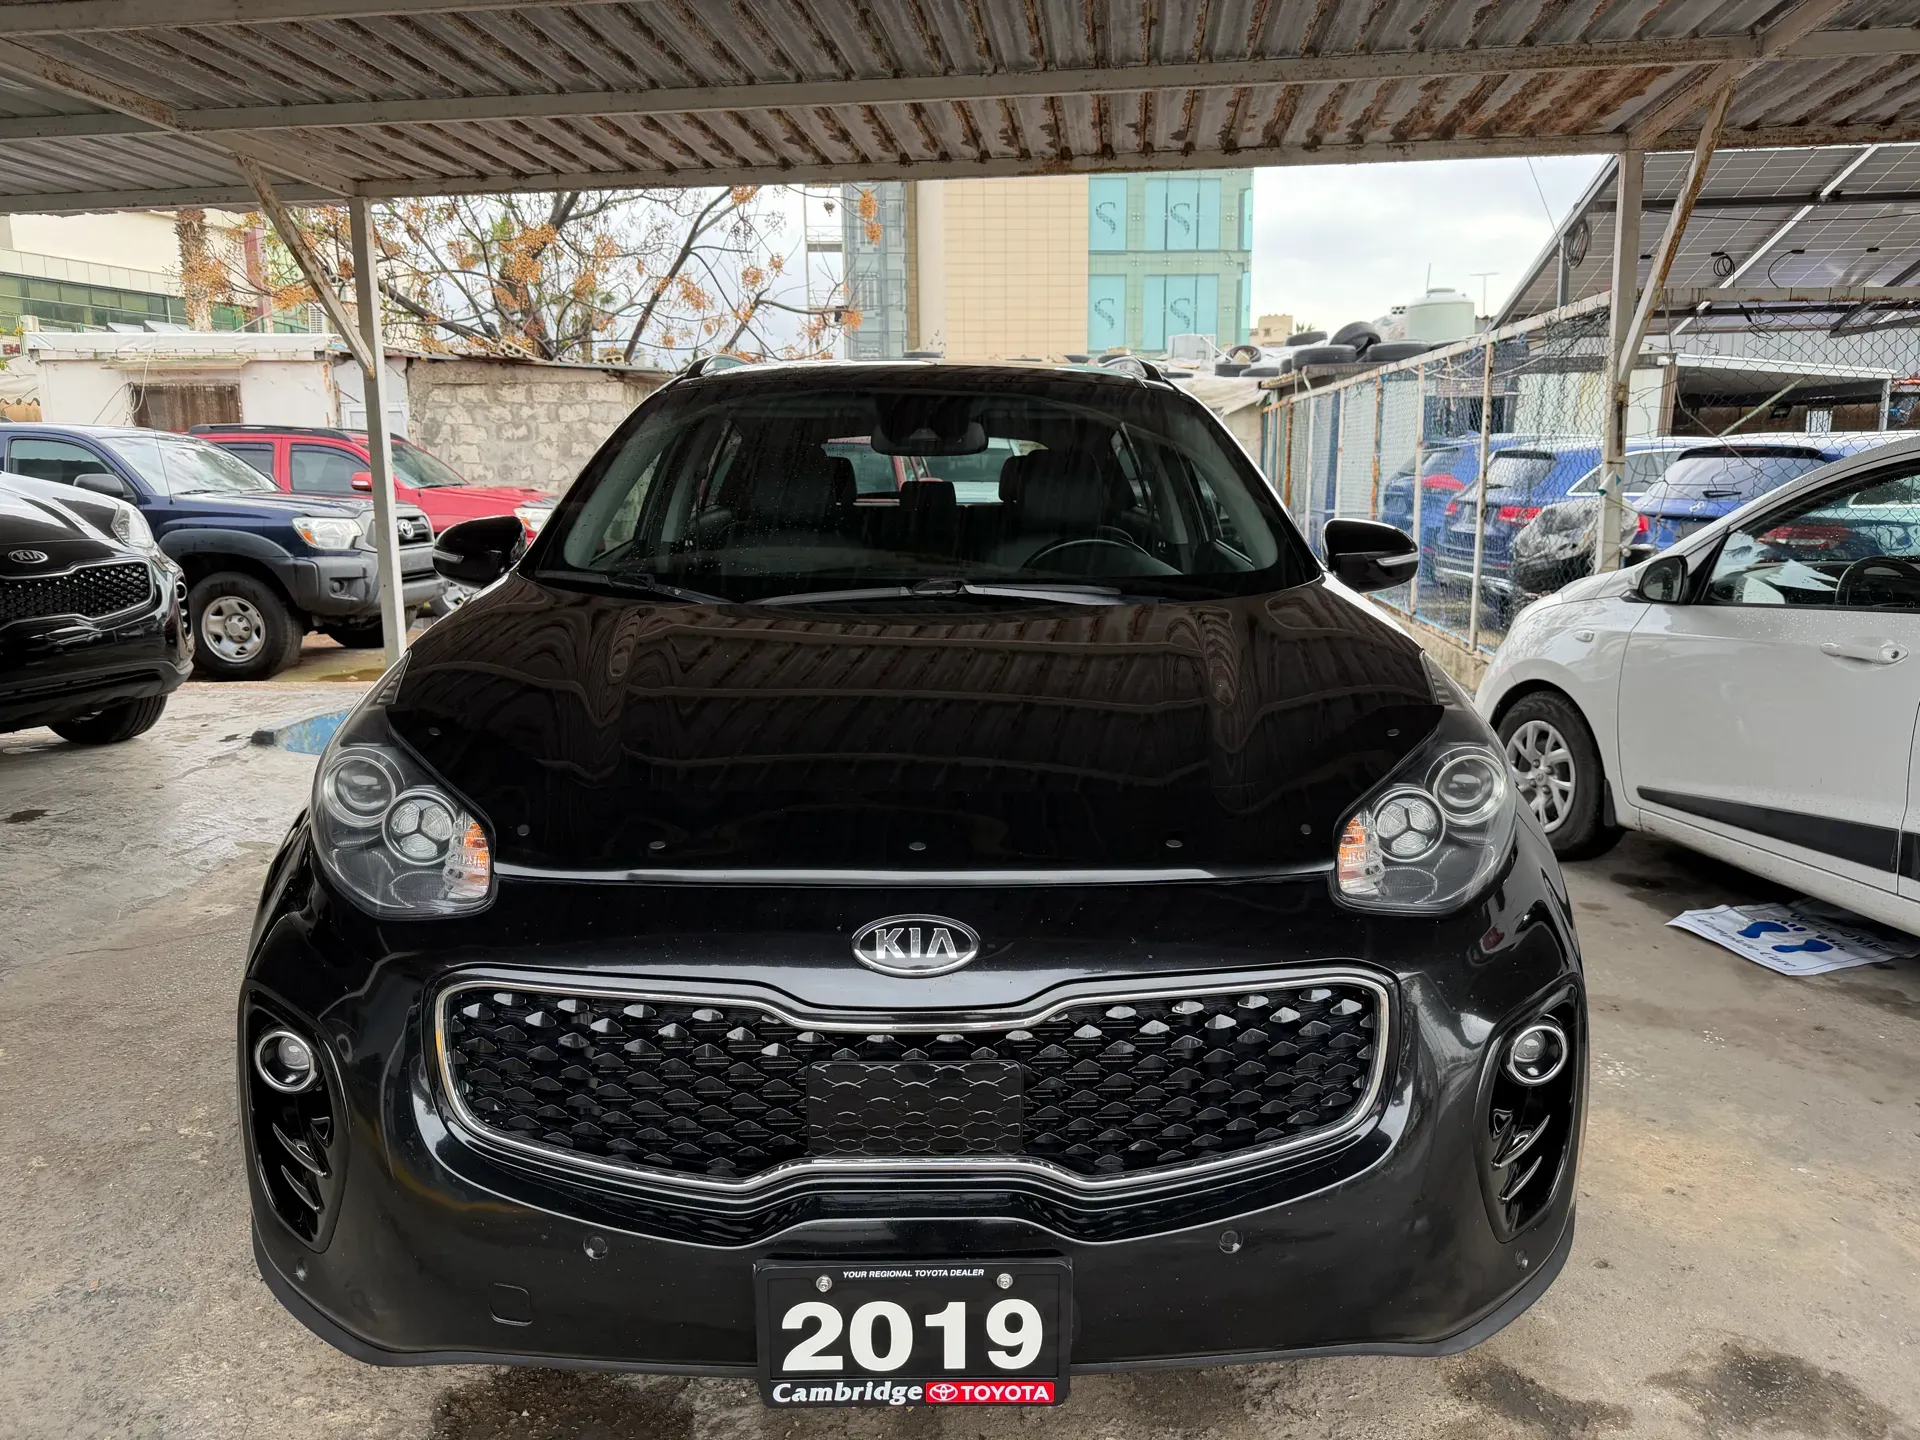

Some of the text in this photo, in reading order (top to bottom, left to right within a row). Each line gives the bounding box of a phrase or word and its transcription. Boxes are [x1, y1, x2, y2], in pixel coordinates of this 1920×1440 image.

[15, 551, 44, 561] KIA
[875, 927, 959, 960] KIA
[843, 1268, 985, 1278] YOUR REGIONAL TOYOTA DEALER
[781, 1298, 1043, 1372] 2019
[772, 1381, 1050, 1405] Cambridge TOYOTA
